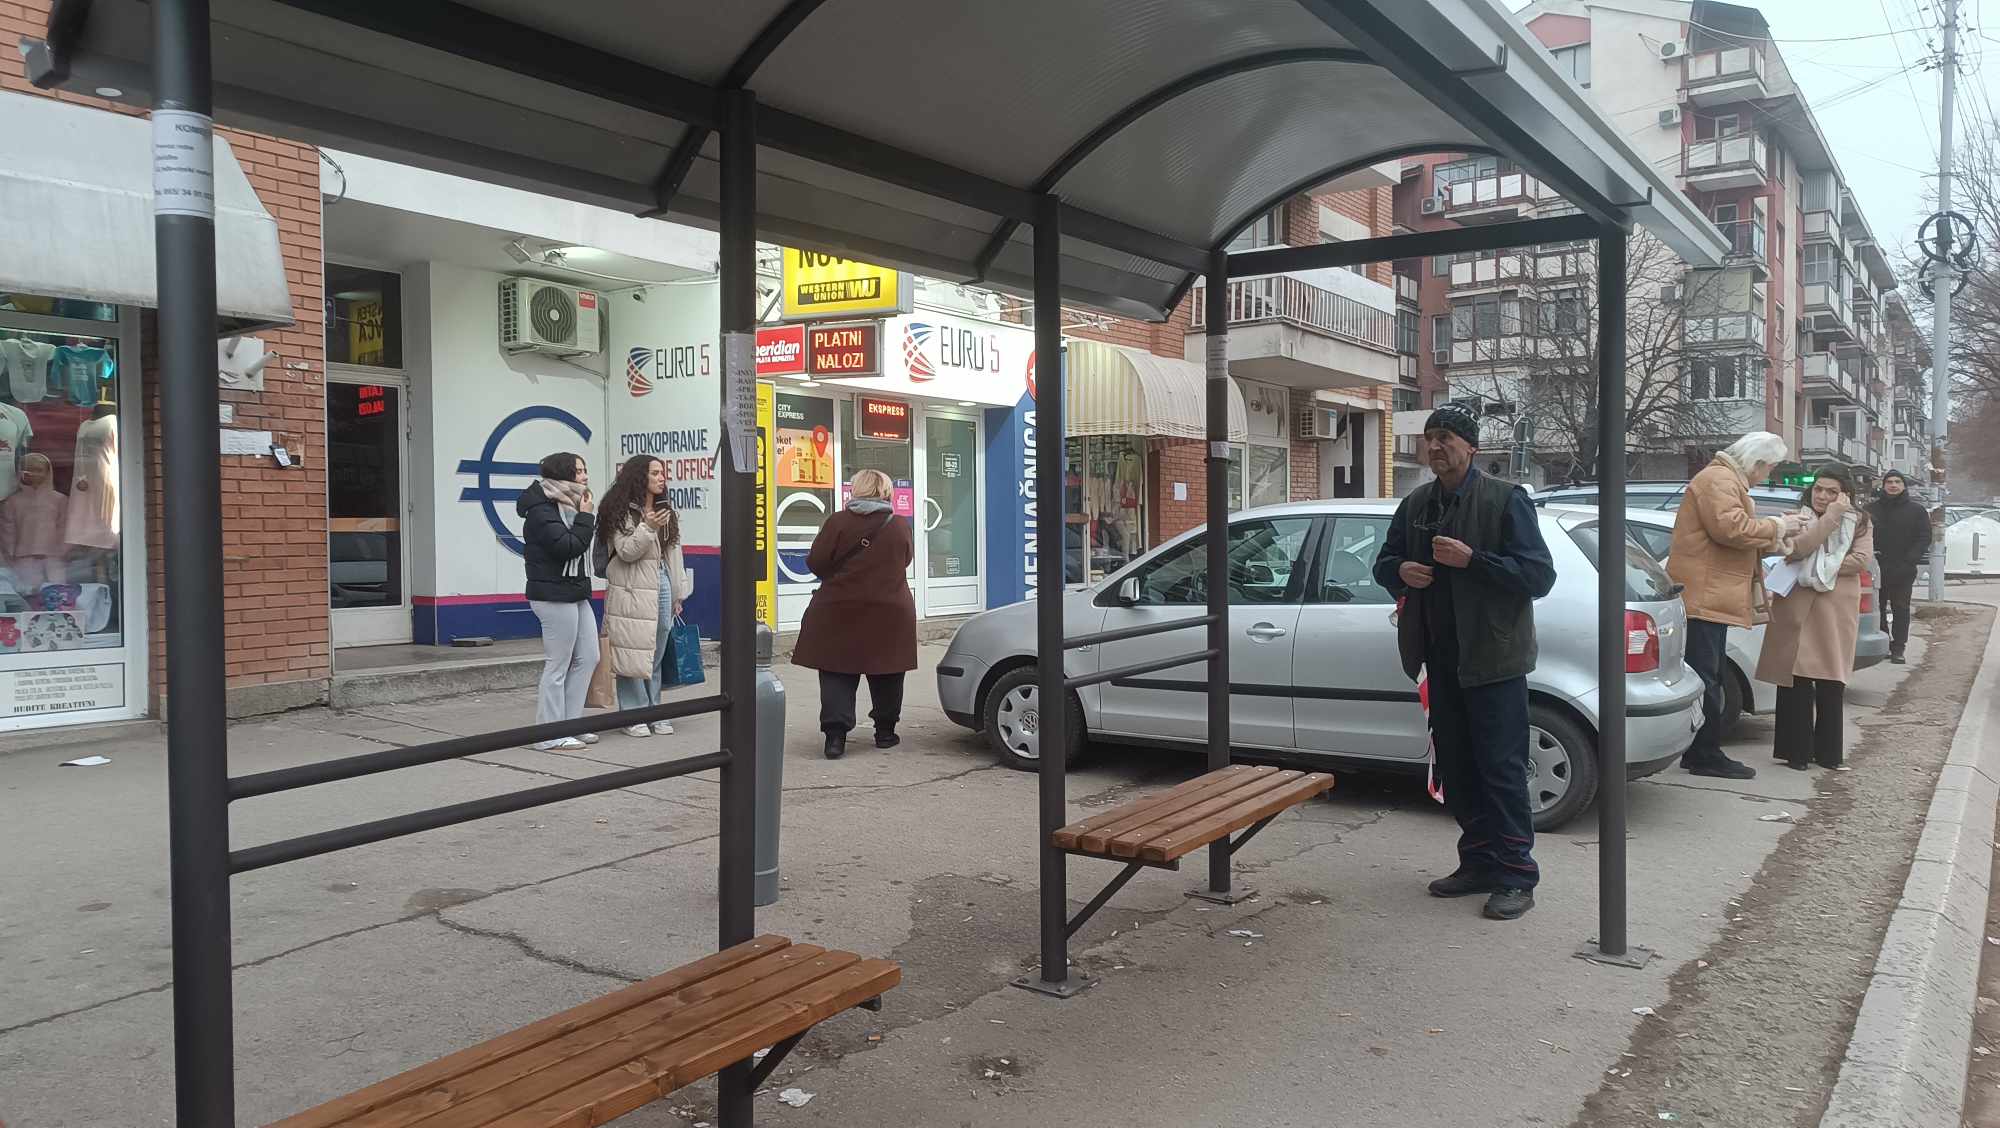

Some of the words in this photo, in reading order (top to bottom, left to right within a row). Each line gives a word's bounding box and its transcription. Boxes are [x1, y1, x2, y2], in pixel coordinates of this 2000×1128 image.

[800, 281, 844, 294] WESTERN
[813, 291, 844, 301] UNION
[815, 330, 863, 348] PLATNI
[656, 346, 696, 380] EURO
[700, 343, 711, 376] 5
[817, 352, 864, 370] NALOZI
[777, 411, 804, 420] EXPRESS
[868, 402, 905, 416] EKSPRESS
[621, 428, 708, 456] FOTOKOPIRANJE
[676, 457, 714, 481] OFFICE
